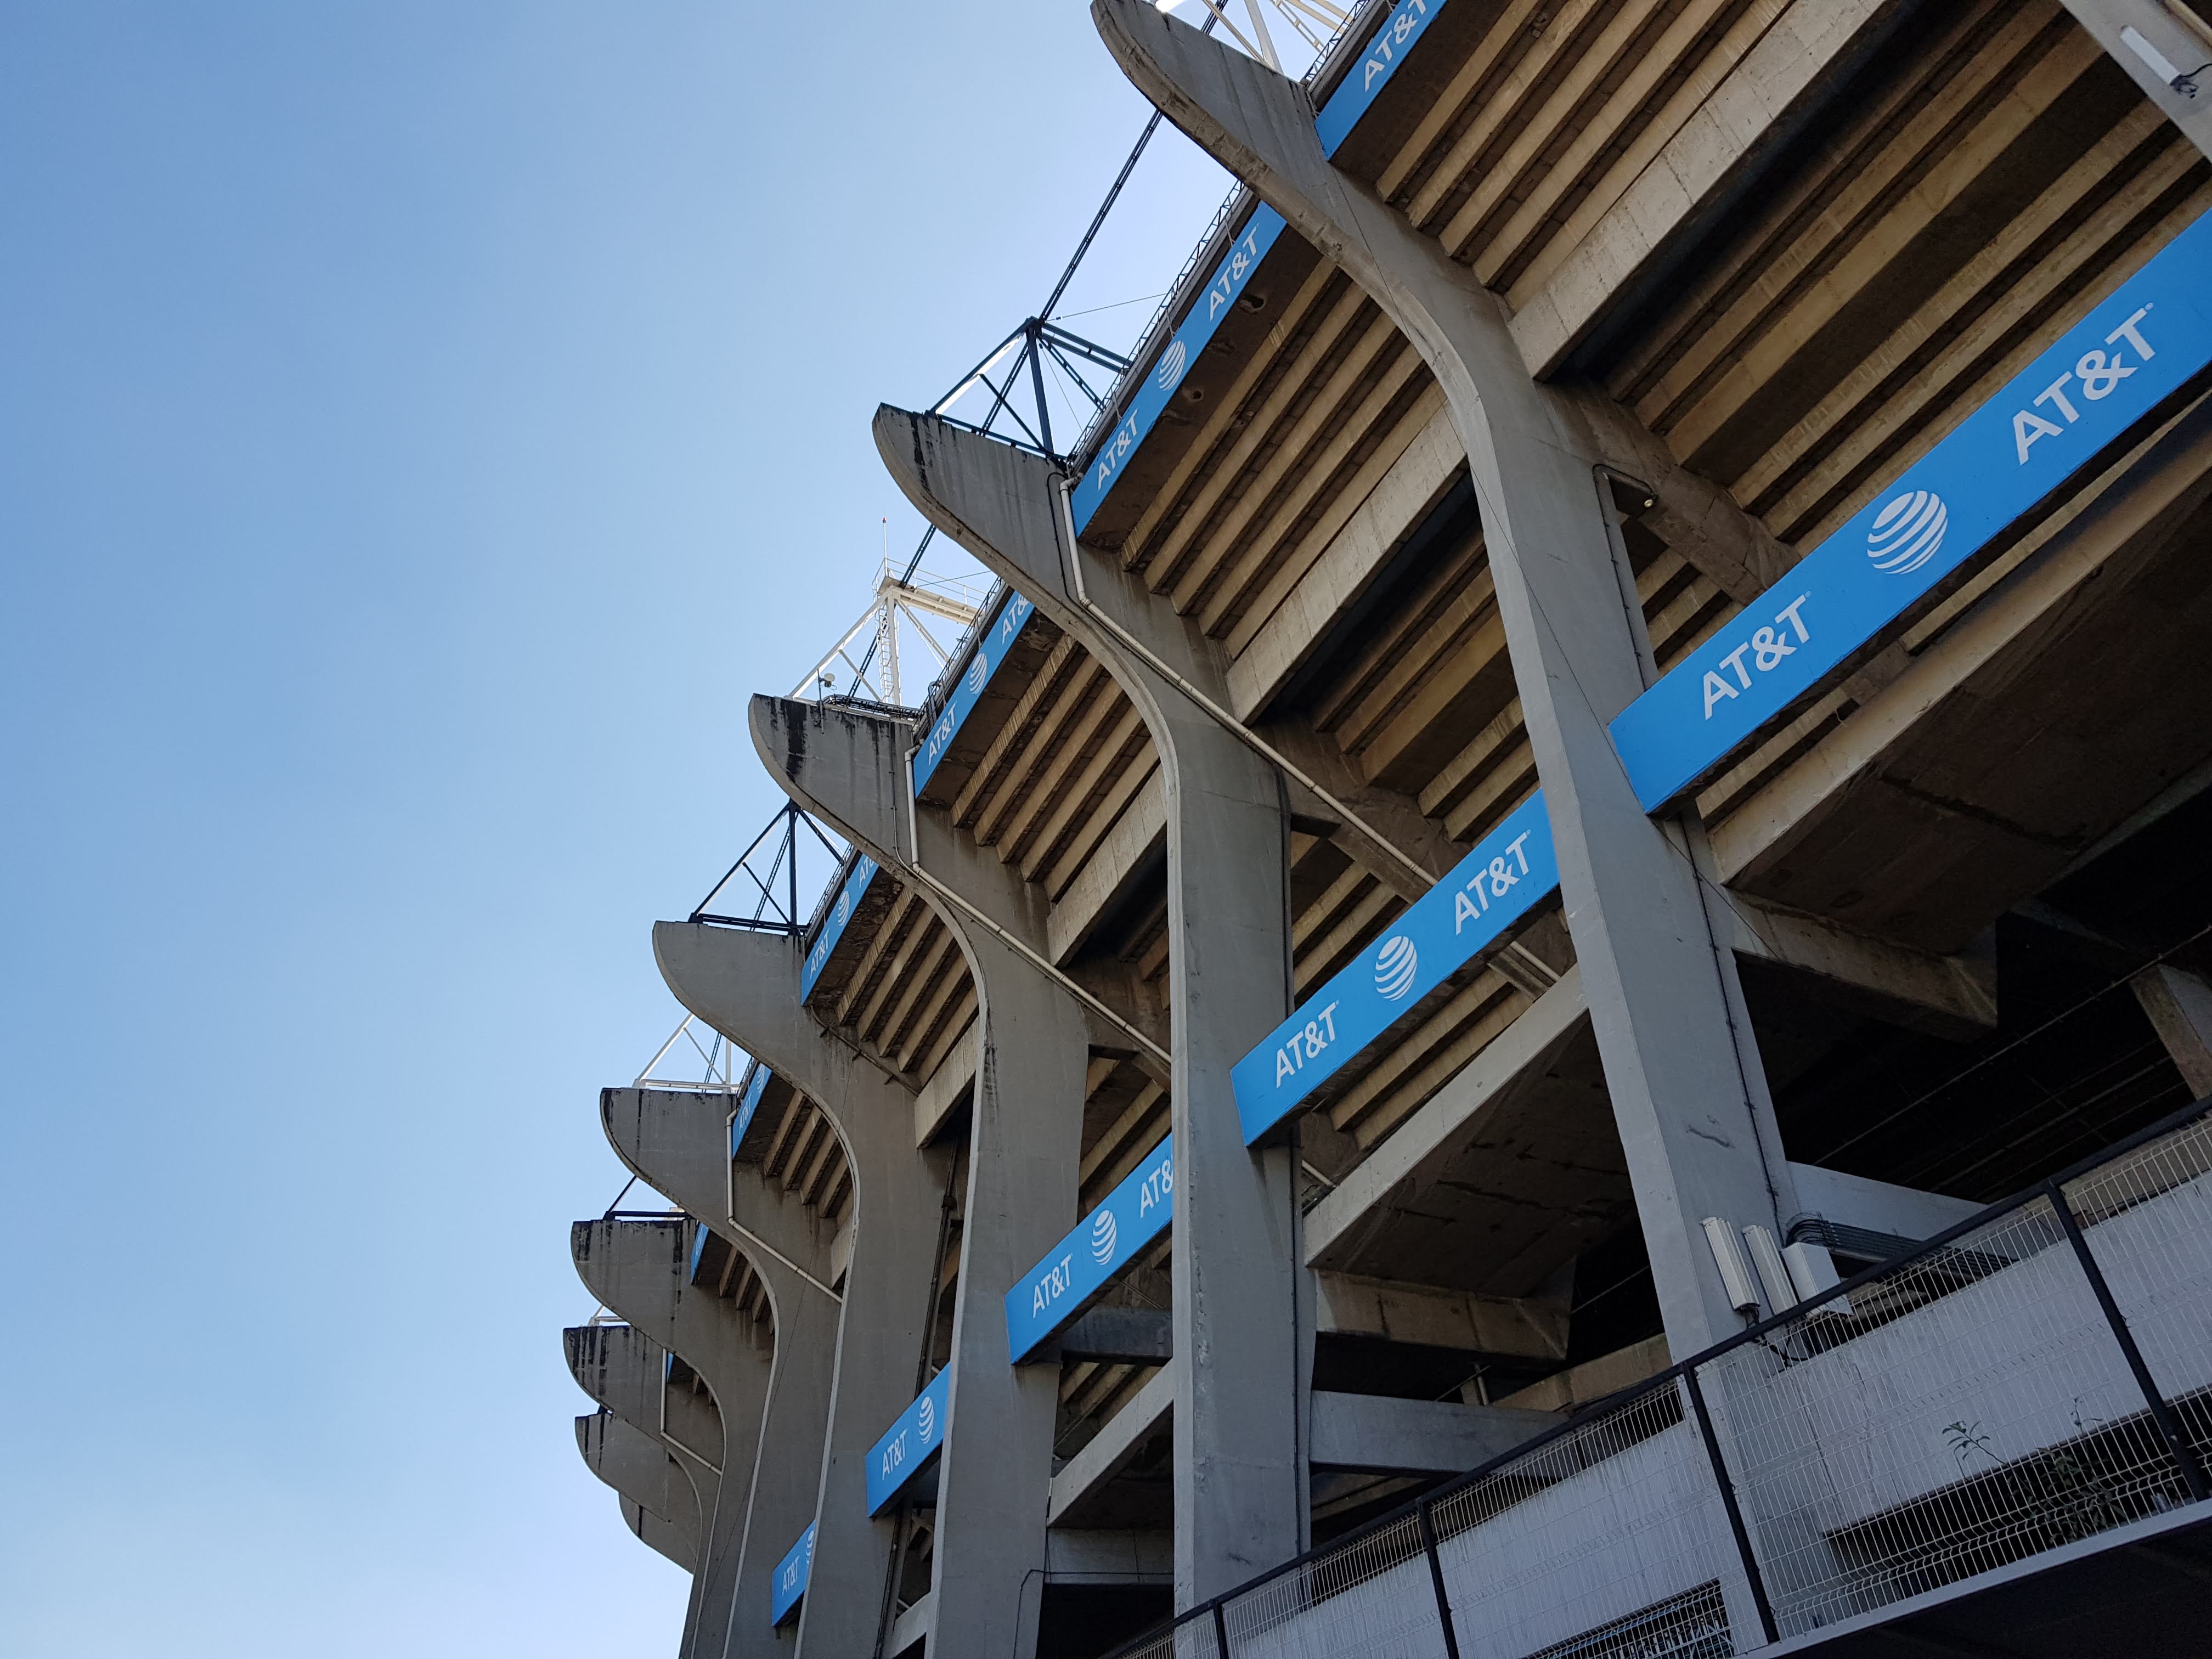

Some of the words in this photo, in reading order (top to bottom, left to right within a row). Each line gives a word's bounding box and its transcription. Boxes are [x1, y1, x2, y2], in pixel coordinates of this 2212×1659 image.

[1099, 409, 1138, 490] AT&T
[1209, 227, 1257, 321] AT&T
[1703, 594, 1812, 720] AT&T
[2013, 308, 2155, 466] AT&T
[928, 703, 956, 766] AT&T
[1002, 594, 1029, 645] AT&
[809, 929, 830, 979] AT&T
[859, 856, 874, 889] AT
[1276, 1002, 1337, 1088] AT&T
[1455, 832, 1531, 935] AT&T
[1032, 1254, 1071, 1318] AT&T
[1140, 1154, 1173, 1218] AT&
[882, 1427, 908, 1481] AT&T
[782, 1555, 799, 1596] AT&T
